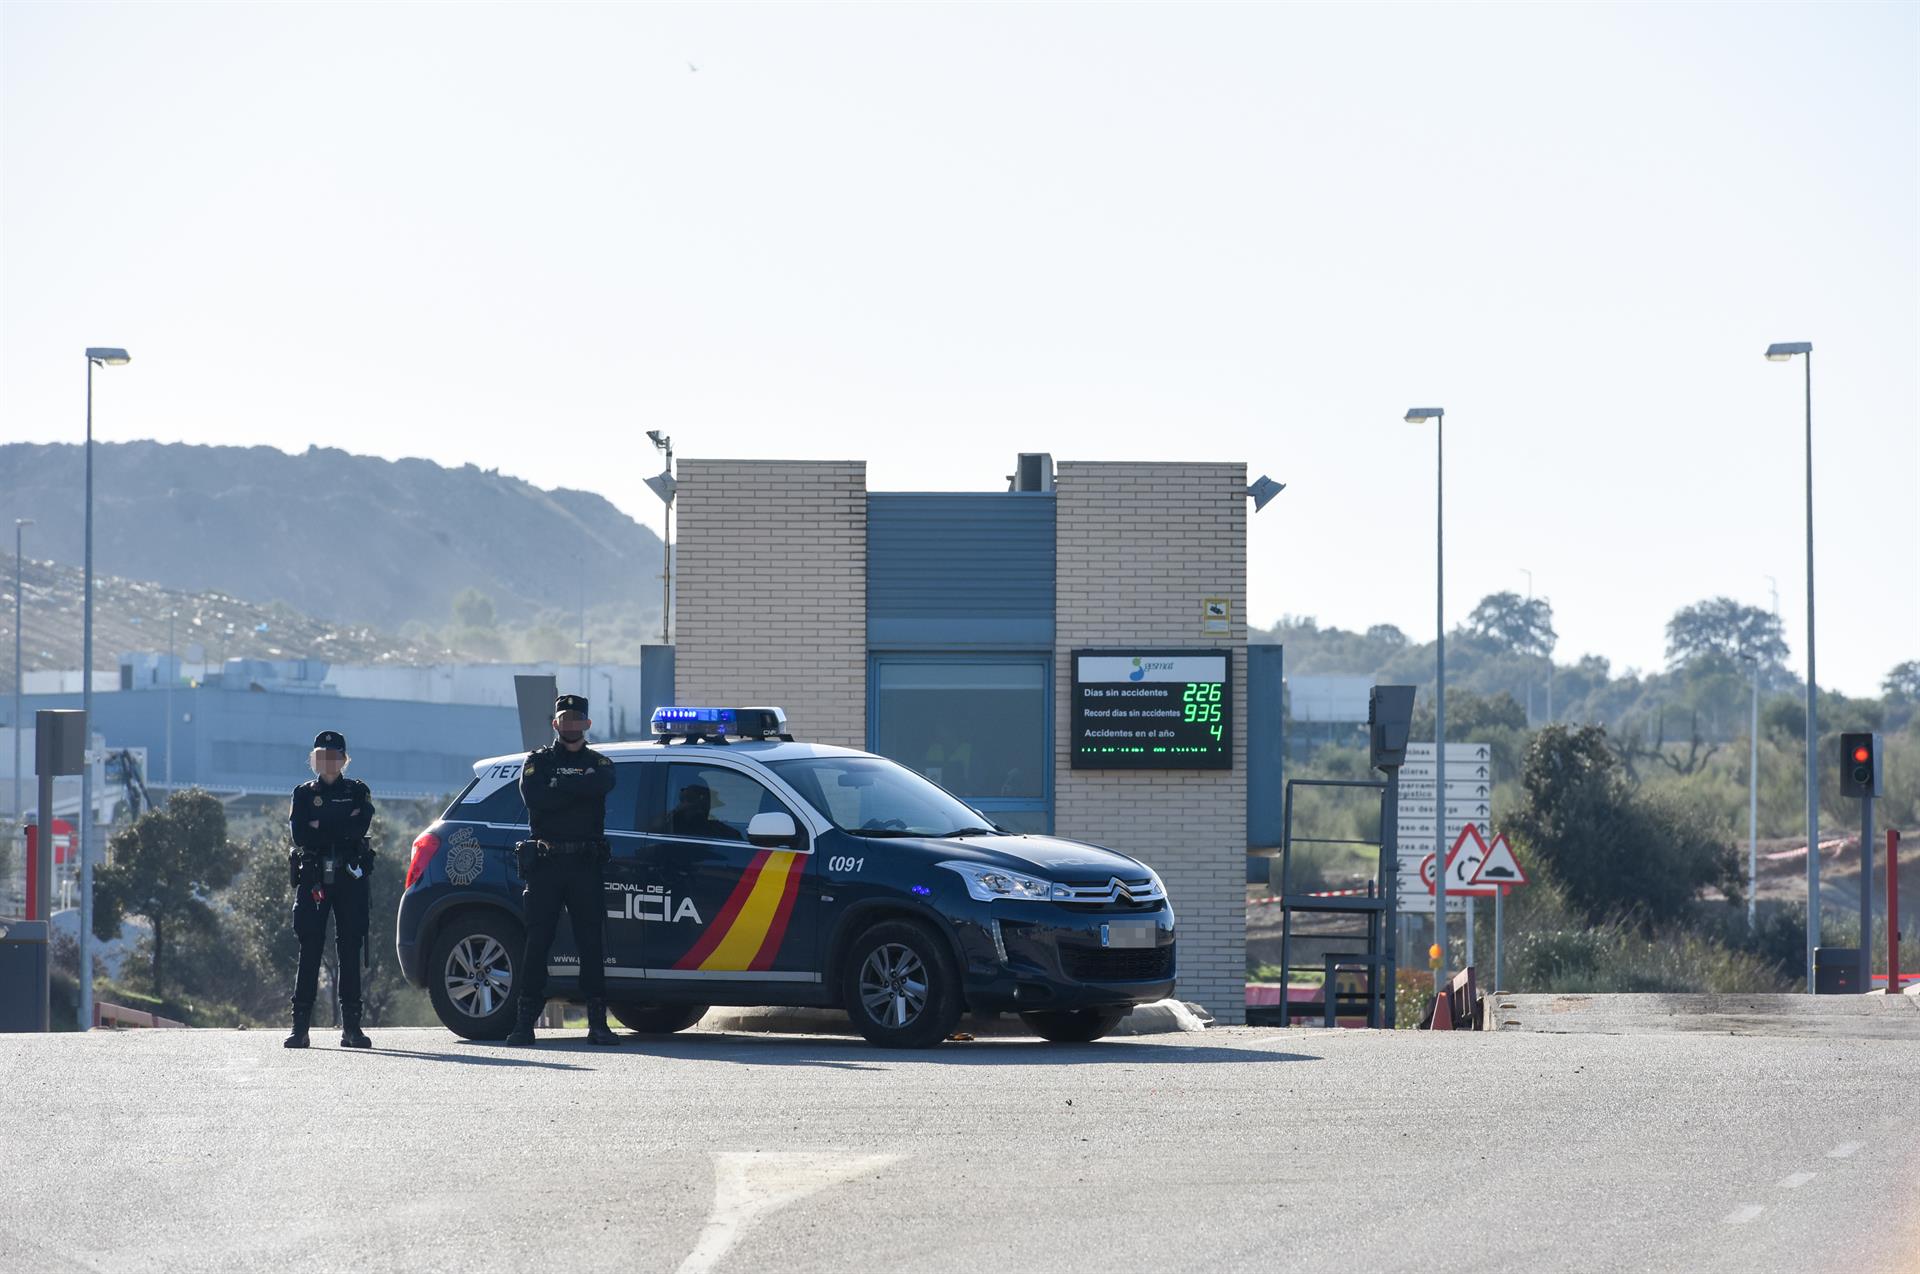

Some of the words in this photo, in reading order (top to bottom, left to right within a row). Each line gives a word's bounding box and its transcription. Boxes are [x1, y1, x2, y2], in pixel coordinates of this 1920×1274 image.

[1105, 689, 1119, 697] sin
[1121, 689, 1168, 697] accidentes
[1183, 683, 1222, 702] 226
[1129, 709, 1140, 717] sin
[1141, 709, 1180, 717] accidentes
[1184, 703, 1222, 722] 935
[1084, 729, 1133, 738] Accidentes
[1148, 729, 1157, 738] el
[1158, 730, 1176, 738] año
[1210, 724, 1222, 741] 4
[835, 856, 864, 873] 091
[647, 885, 664, 893] DE
